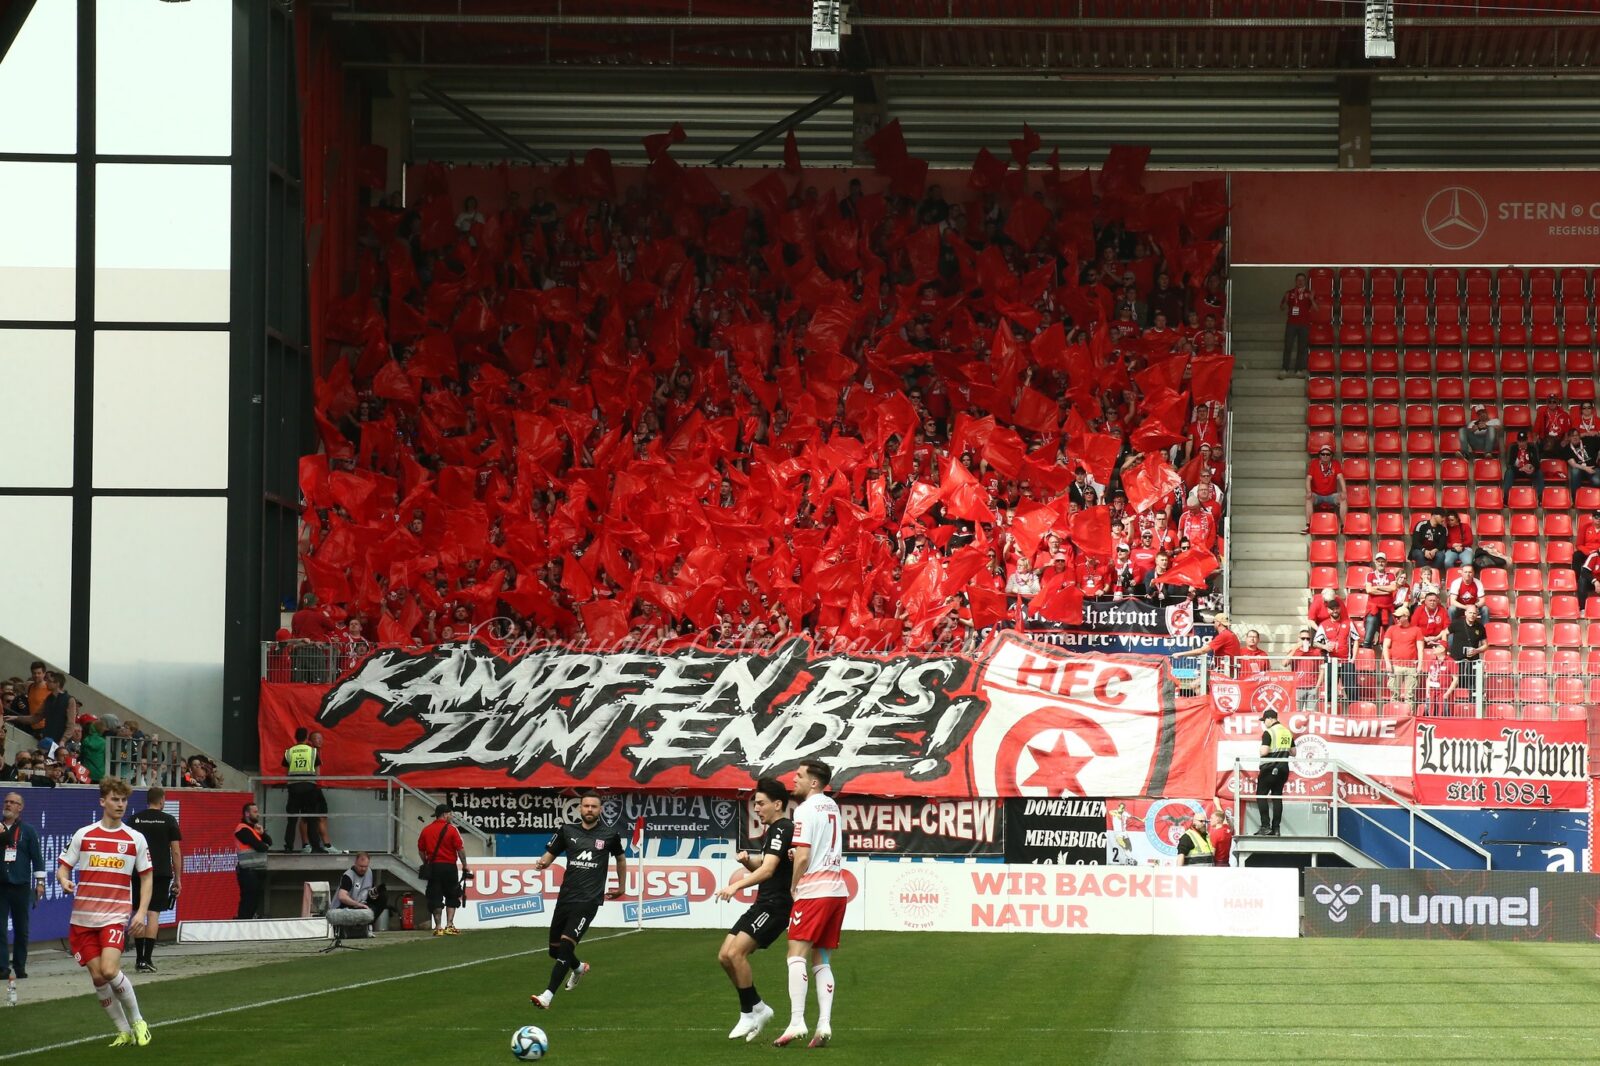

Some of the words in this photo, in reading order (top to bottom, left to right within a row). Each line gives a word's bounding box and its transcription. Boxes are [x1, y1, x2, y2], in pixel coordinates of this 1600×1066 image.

[1498, 202, 1566, 220] STERN
[798, 656, 957, 717] BIS
[1016, 655, 1133, 706] HFC
[1223, 714, 1267, 735] HF
[1289, 714, 1397, 739] CHEMIE
[379, 696, 627, 775] ZUM
[626, 697, 971, 779] ENDE!
[1281, 736, 1290, 746] 261
[1418, 723, 1587, 778] Leuna-Löwen
[294, 759, 307, 768] 127
[450, 792, 517, 810] Libertà
[1447, 780, 1486, 802] seit
[1494, 781, 1553, 805] 1984
[1024, 799, 1106, 818] DOMFALKEN
[517, 811, 564, 829] Halle
[646, 822, 710, 832] Surrender
[827, 813, 837, 853] 7
[1024, 830, 1107, 848] MERSEBURG
[848, 835, 896, 850] Halle
[89, 854, 125, 869] Netto
[1112, 847, 1119, 863] 2
[570, 860, 598, 869] MOBILEBET
[970, 872, 1047, 896] WIR
[1055, 872, 1199, 898] BACKEN
[484, 899, 537, 915] Modestraße
[900, 892, 940, 904] HAHN
[1223, 897, 1264, 909] HAHN
[1371, 883, 1539, 927] hummel
[755, 911, 770, 928] 10
[970, 903, 1089, 929] NATUR
[109, 928, 124, 945] 27
